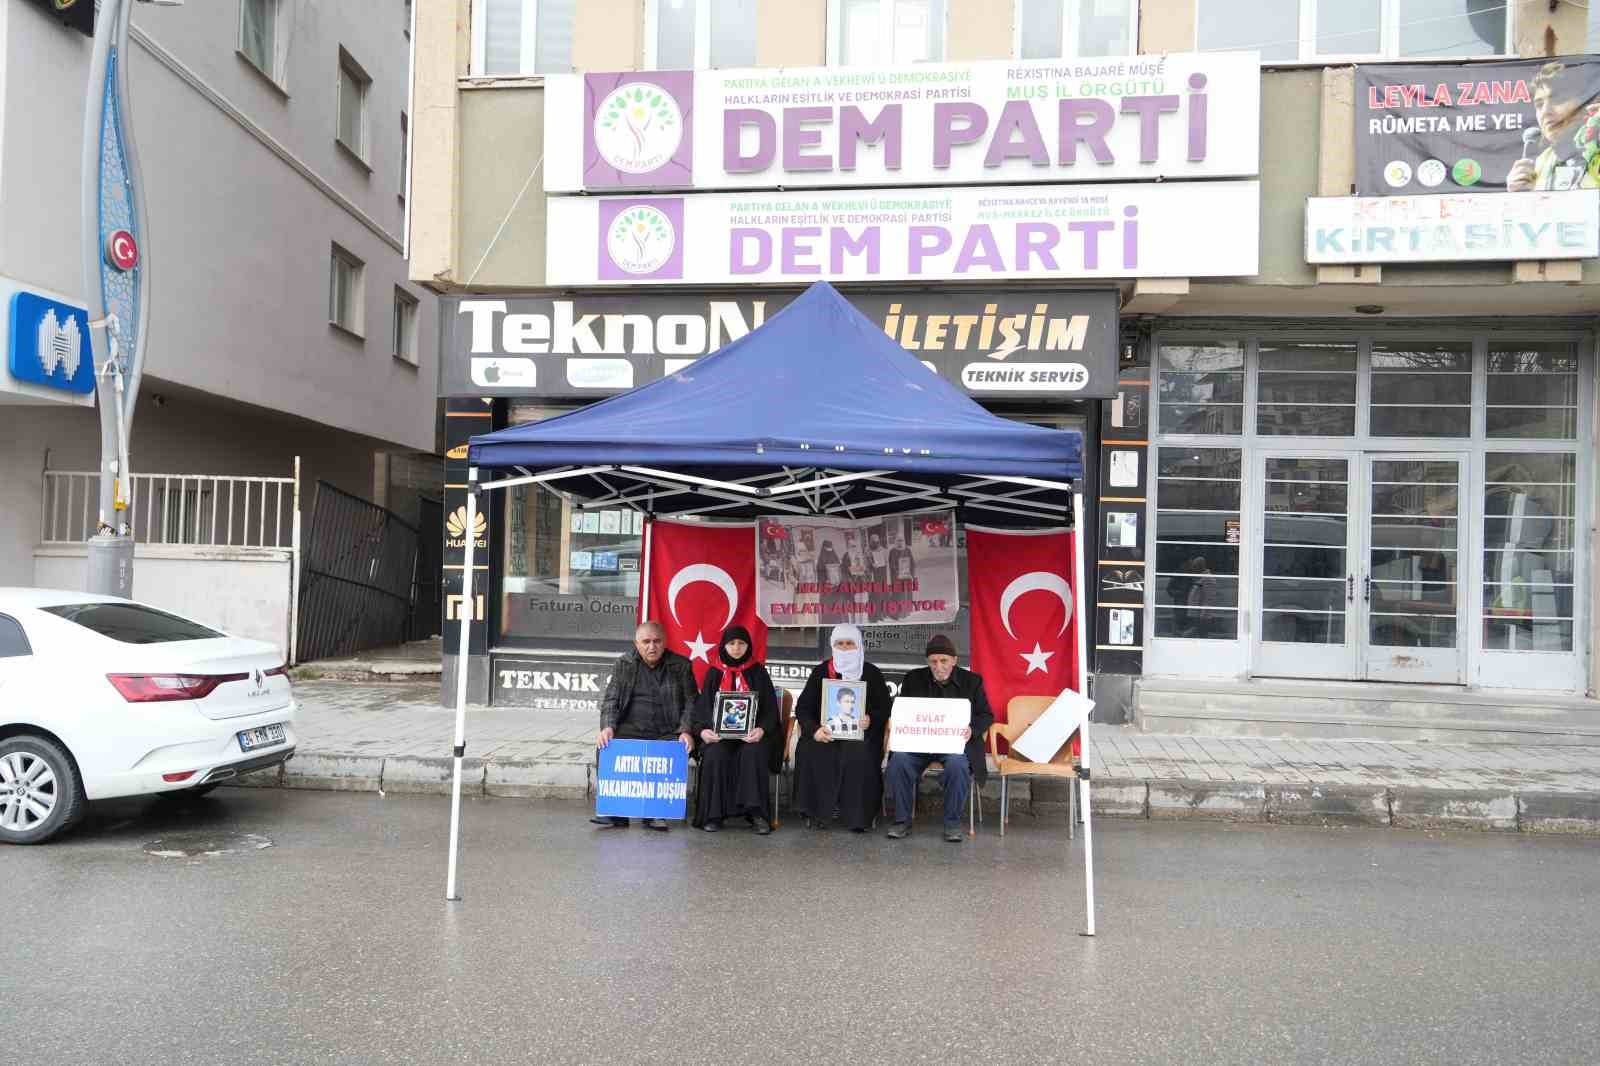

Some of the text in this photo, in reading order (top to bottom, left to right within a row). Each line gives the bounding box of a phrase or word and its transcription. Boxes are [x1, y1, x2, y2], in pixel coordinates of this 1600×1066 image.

[725, 94, 789, 104] HALKLARIN
[838, 91, 852, 102] VE
[855, 88, 921, 102] DEMOKRASİ
[926, 86, 971, 99] PARTİSİ
[1080, 78, 1165, 97] ÖRGÜTÜ
[1369, 80, 1532, 109] LEYLA ZANA
[723, 72, 1208, 173] DEM PARTİ
[1369, 113, 1523, 134] RÛMETA ME YE!
[730, 215, 789, 225] HALKLARIN
[832, 214, 845, 224] VE
[848, 211, 907, 224] DEMOKRASİ
[911, 210, 952, 223] PARTİSİ
[729, 205, 1139, 275] DEM PARTİ
[885, 304, 1090, 360] İLETİŞİM
[967, 369, 1084, 383] TEKNİK SERVİS
[528, 598, 585, 613] Fatura
[916, 713, 945, 723] EVLAT
[614, 755, 640, 773] ARTIK
[641, 756, 668, 775] YETER
[599, 777, 687, 804] YAKAMIZDAN DÜŞÜN
